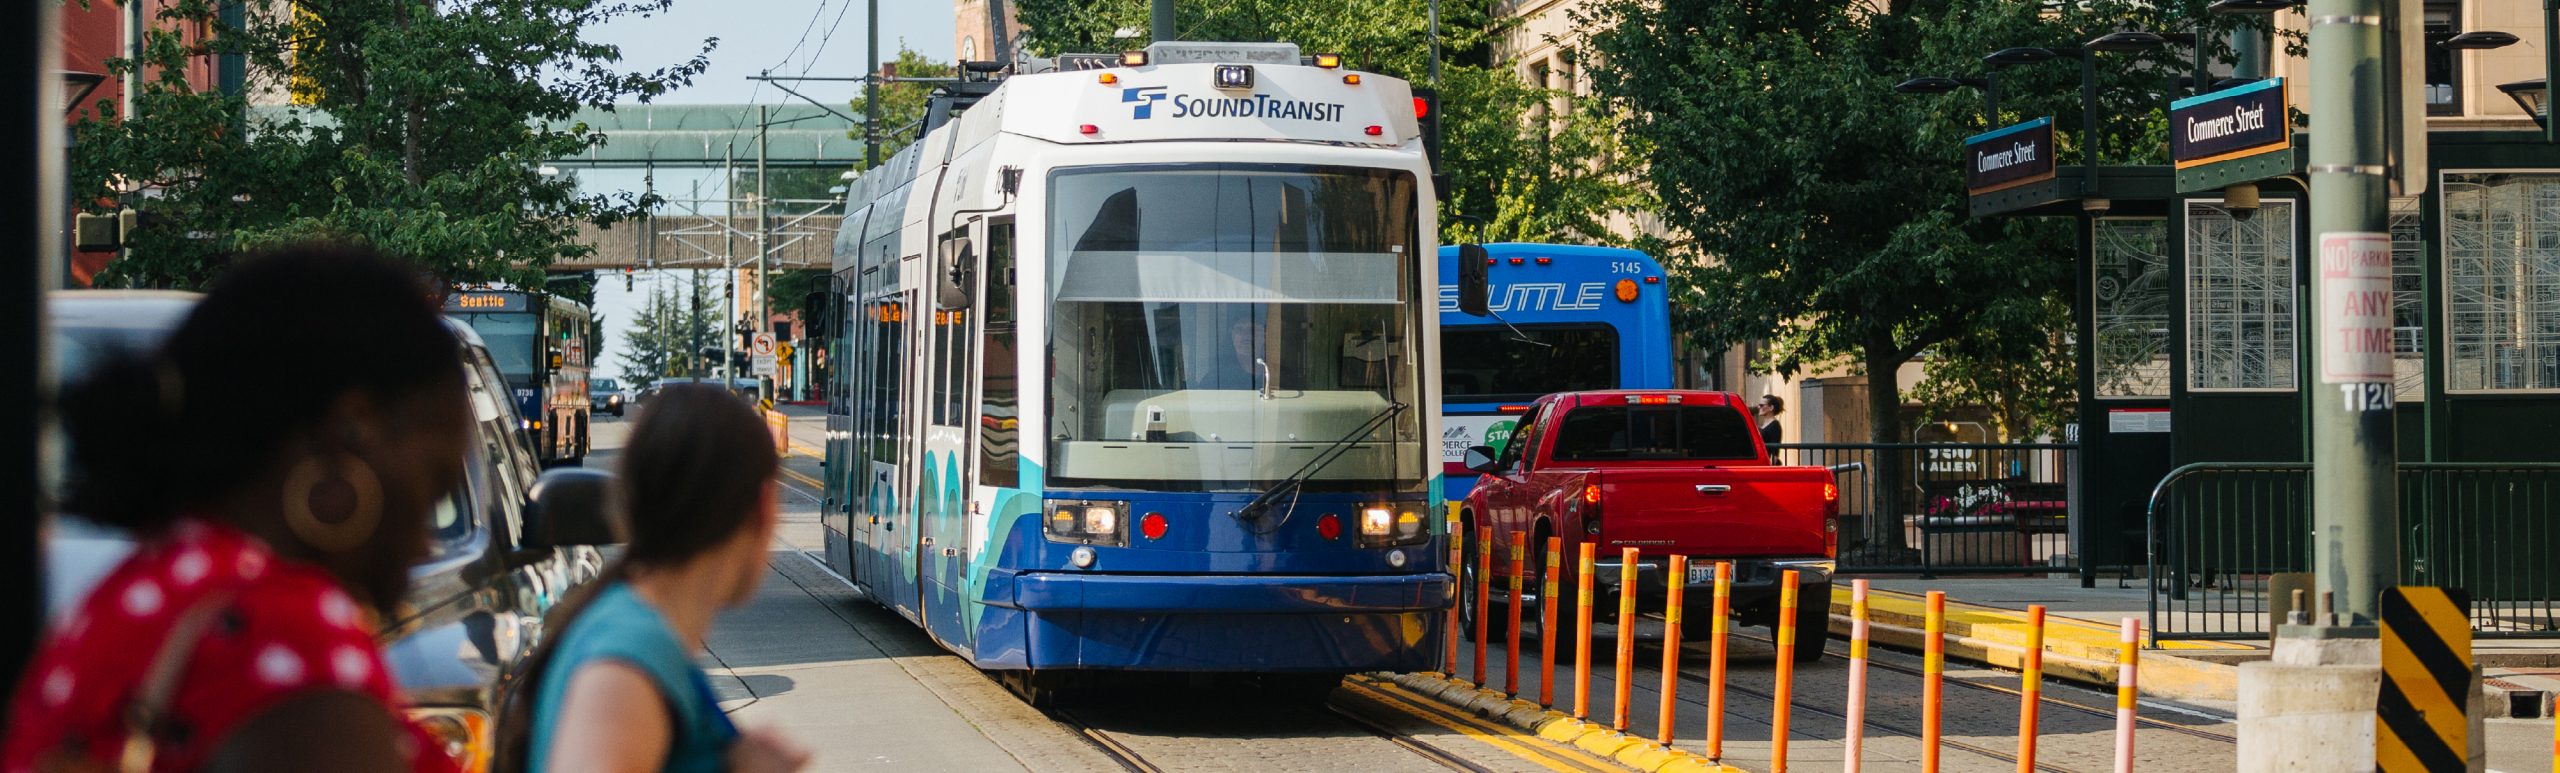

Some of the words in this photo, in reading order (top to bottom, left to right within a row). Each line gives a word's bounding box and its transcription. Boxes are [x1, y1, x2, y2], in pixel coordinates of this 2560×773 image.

[2187, 116, 2234, 143] Commerce
[2235, 102, 2264, 133] Street
[1978, 150, 2013, 173] Commerce
[2014, 140, 2036, 165] Street
[1612, 262, 1641, 274] 5145
[2325, 245, 2348, 273] NO
[2350, 250, 2391, 268] PARKIN
[460, 294, 505, 308] Seattle
[1439, 282, 1606, 312] SUTTLE
[2344, 291, 2389, 317] ANY
[2340, 327, 2392, 353] TIME
[1488, 429, 1513, 443] STA
